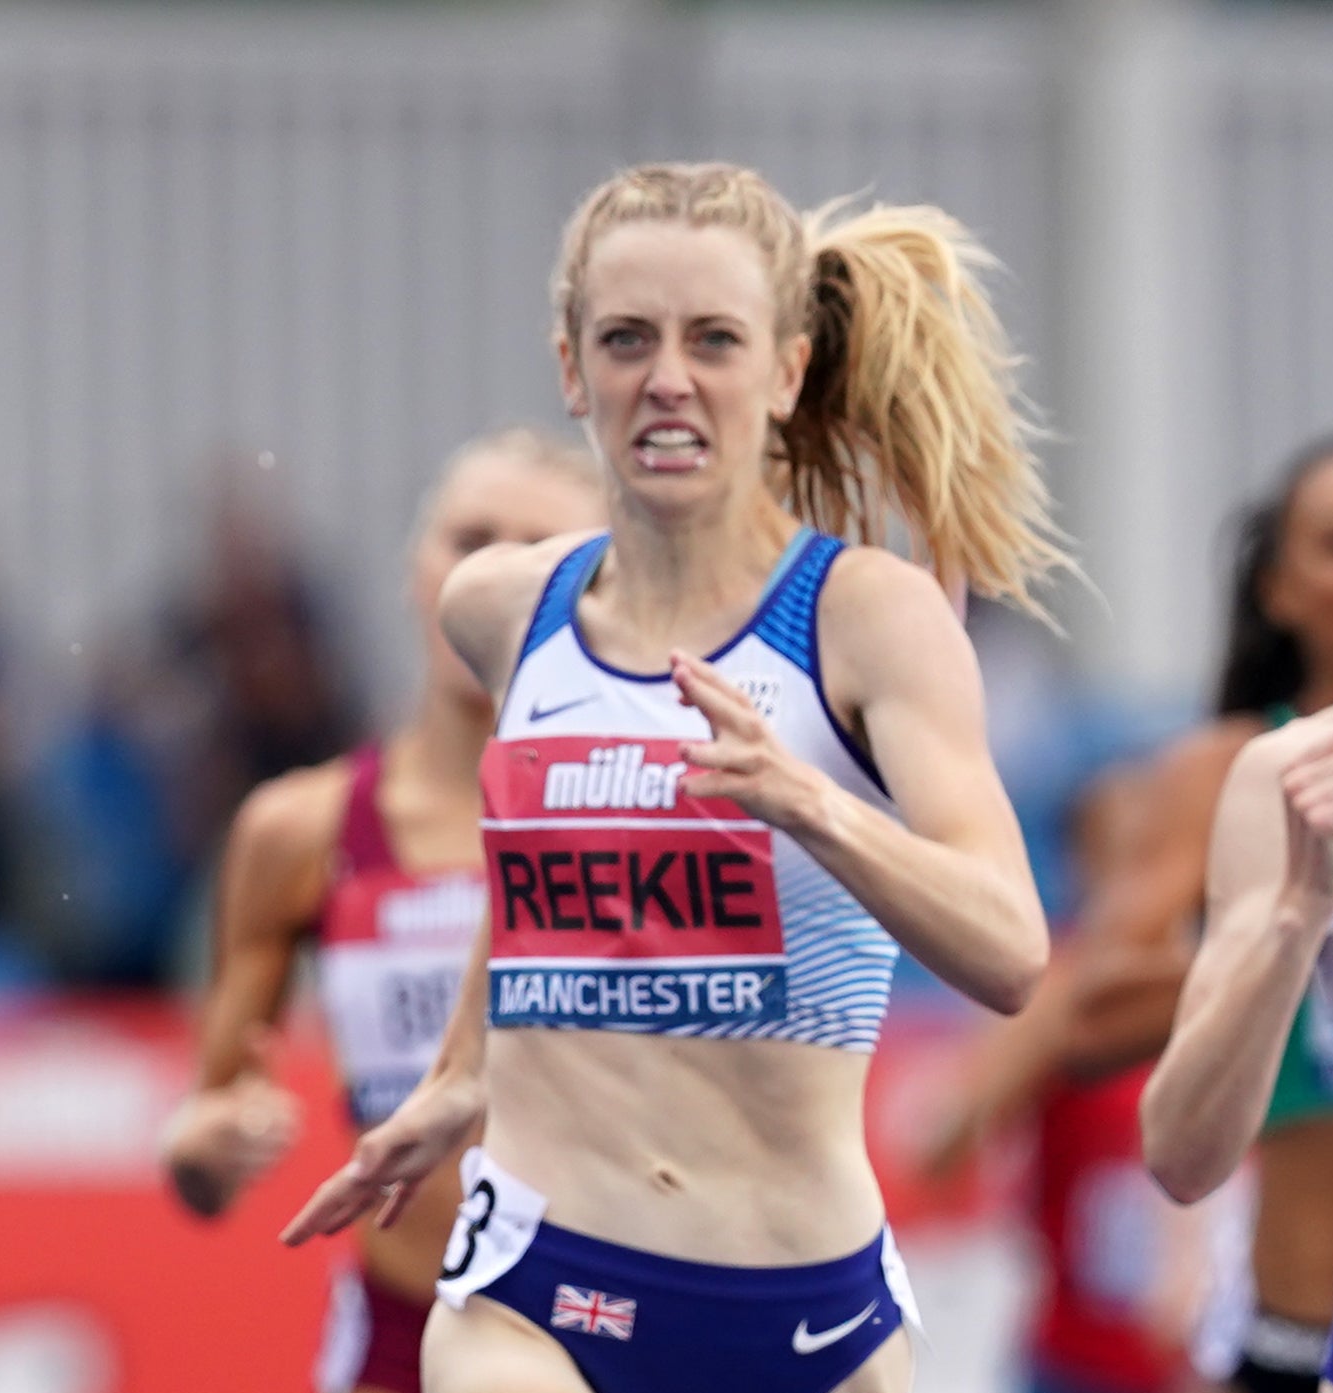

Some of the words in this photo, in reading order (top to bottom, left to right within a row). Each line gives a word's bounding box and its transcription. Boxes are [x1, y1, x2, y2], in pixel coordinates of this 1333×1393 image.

[544, 744, 688, 810] müller
[498, 851, 762, 931] REEKIE
[499, 972, 765, 1014] MANCHESTER
[439, 1179, 497, 1281] 3
